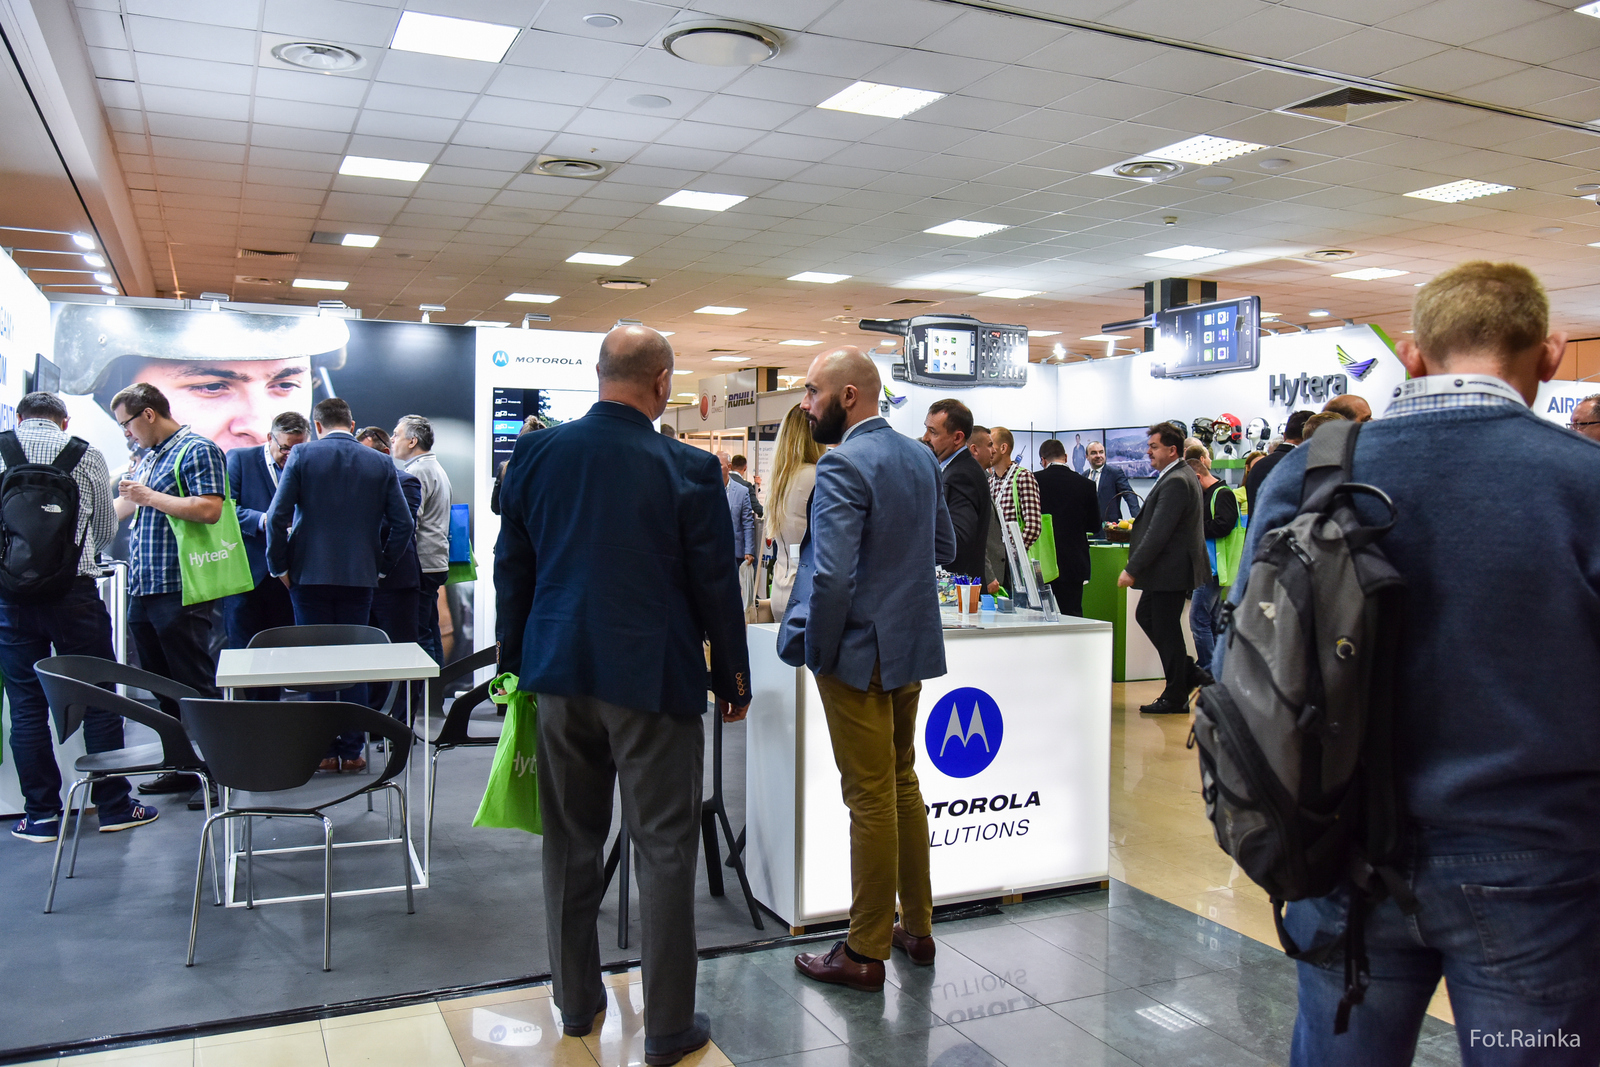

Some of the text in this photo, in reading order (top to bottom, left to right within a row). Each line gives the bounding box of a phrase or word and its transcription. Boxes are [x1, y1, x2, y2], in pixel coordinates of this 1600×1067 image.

[515, 356, 583, 365] MOTOROLA
[1269, 372, 1348, 407] Hytera
[728, 391, 755, 408] ROHILL
[1547, 396, 1582, 413] AIR
[189, 549, 229, 567] Hytera
[925, 791, 1041, 819] TOROLA
[930, 819, 1030, 848] LUTIONS
